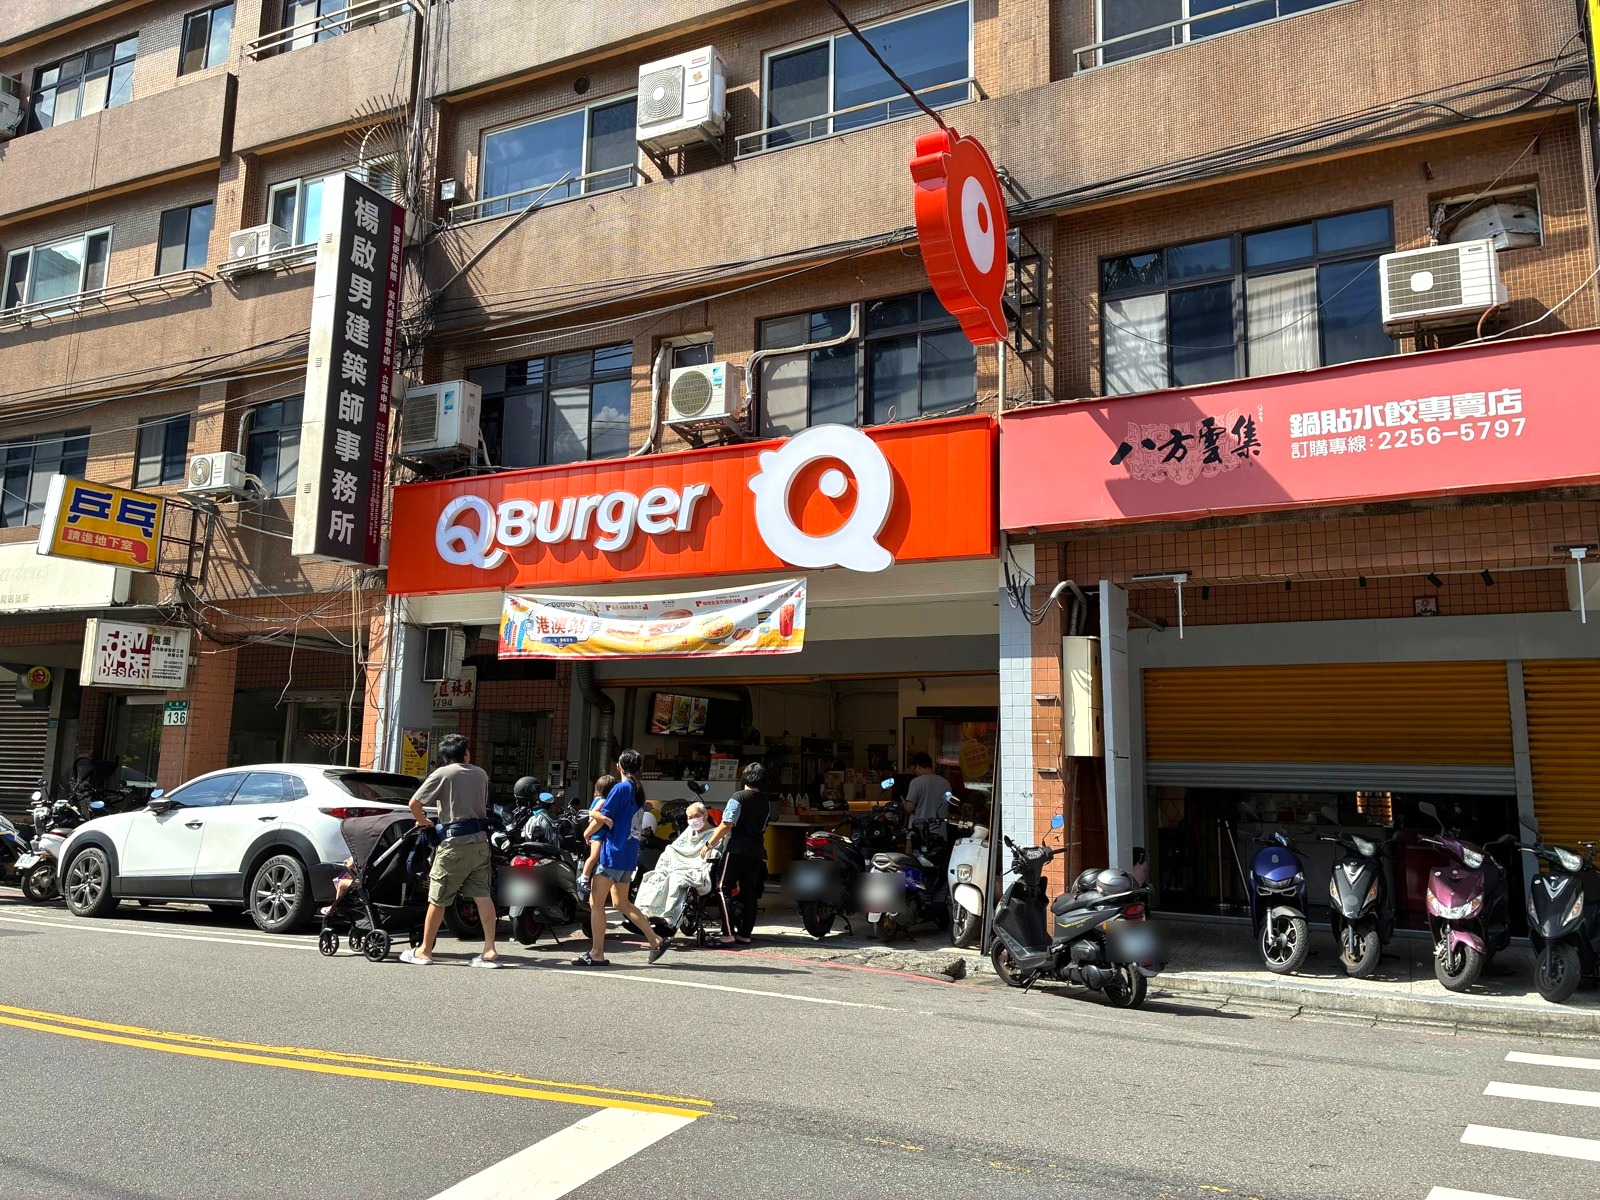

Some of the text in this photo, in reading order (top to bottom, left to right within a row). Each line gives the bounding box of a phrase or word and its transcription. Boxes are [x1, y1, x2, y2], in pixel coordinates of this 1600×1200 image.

[1289, 389, 1523, 439] 鍋貼水餃專賣店
[1110, 414, 1263, 466] 八方雲集
[67, 487, 158, 538] 乒乓
[67, 529, 134, 551] 請進地下室
[536, 615, 588, 635] 港澳站
[98, 665, 150, 679] DESIGN
[167, 711, 187, 725] 136
